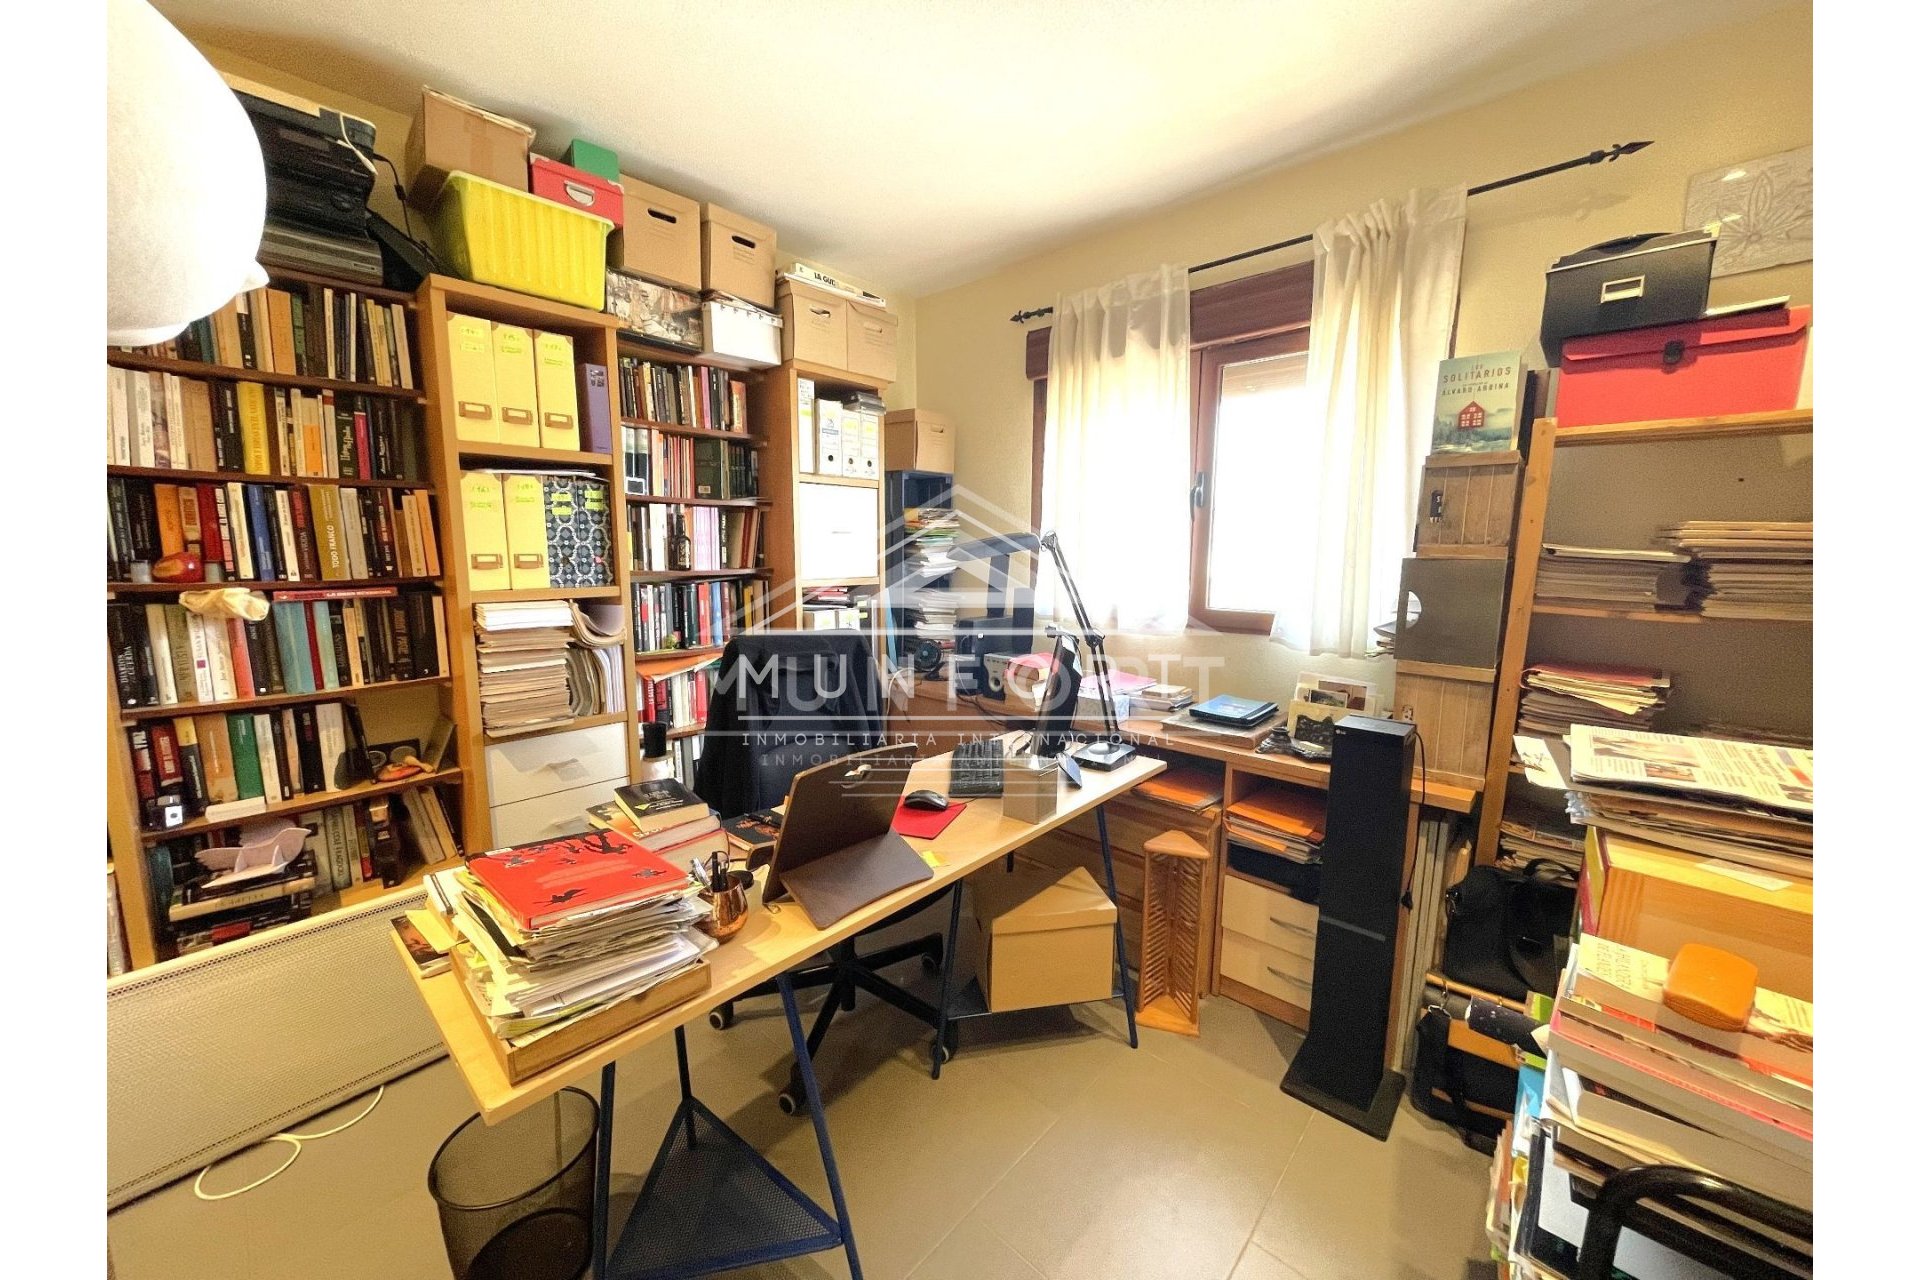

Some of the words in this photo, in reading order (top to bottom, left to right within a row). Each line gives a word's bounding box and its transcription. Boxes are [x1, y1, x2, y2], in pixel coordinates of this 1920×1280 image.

[1442, 366, 1512, 384] SOLITARIOS
[328, 524, 338, 550] FRANCO
[331, 552, 341, 569] TODO
